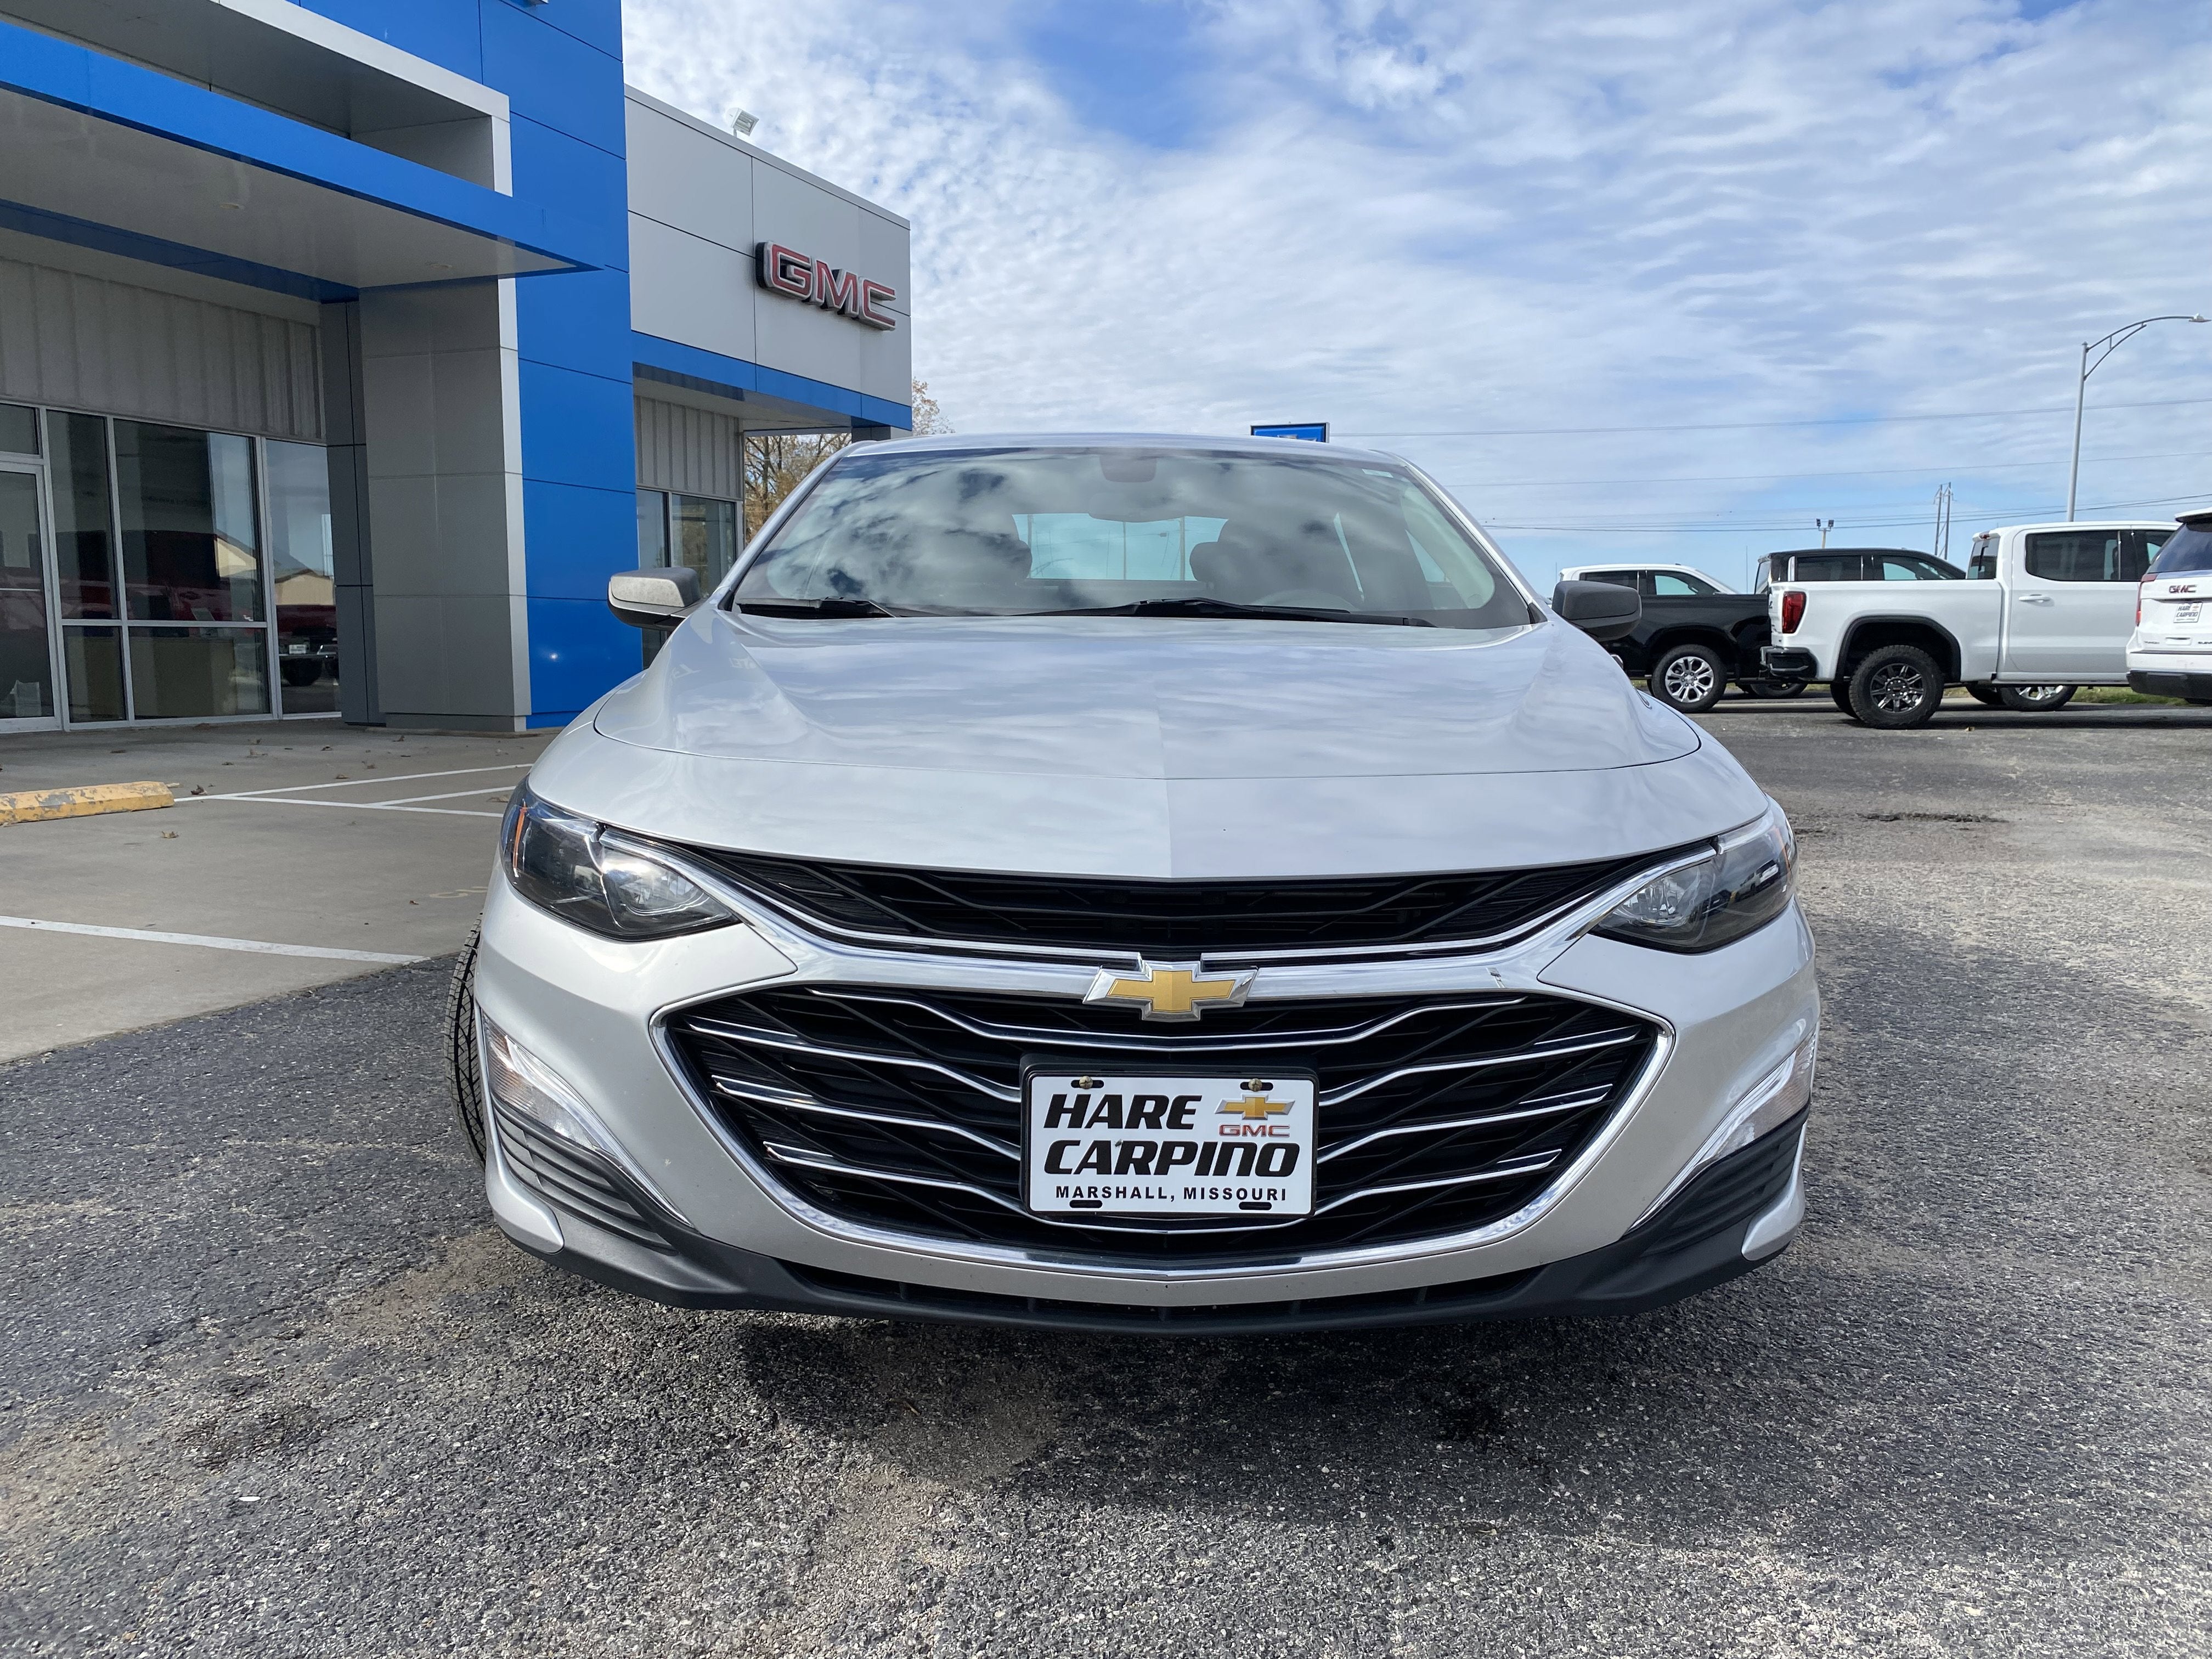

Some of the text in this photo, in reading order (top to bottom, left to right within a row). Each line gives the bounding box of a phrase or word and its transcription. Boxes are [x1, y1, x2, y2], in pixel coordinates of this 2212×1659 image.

[757, 241, 896, 331] GMC
[2169, 585, 2197, 593] GMC
[1043, 1093, 1203, 1130] HARE
[1218, 1124, 1290, 1137] GMC
[1044, 1139, 1300, 1177] CARPINO
[1056, 1186, 1286, 1202] MARSHALL, MISSOURI
